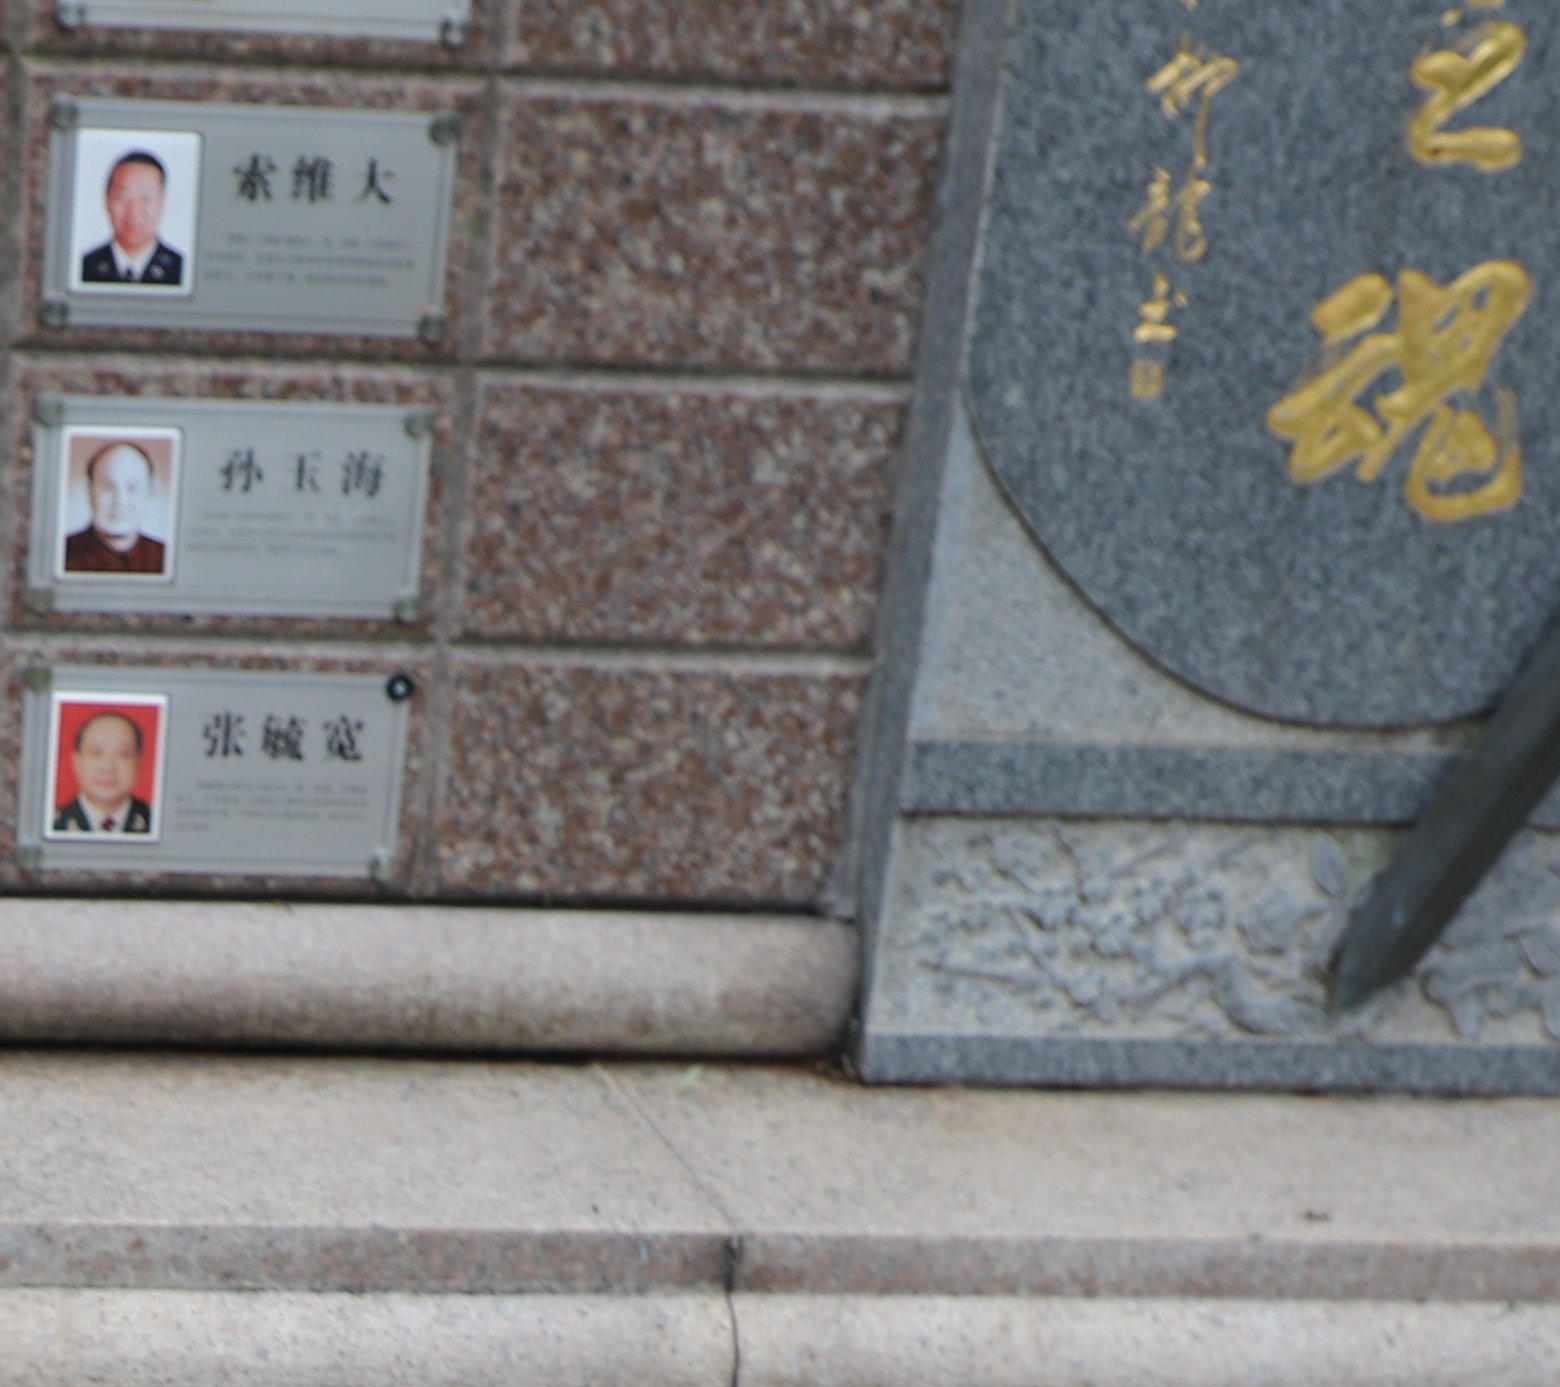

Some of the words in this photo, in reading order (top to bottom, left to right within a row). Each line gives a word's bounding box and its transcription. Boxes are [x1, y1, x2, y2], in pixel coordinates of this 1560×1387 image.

[1266, 0, 1533, 521] 之魂
[219, 448, 386, 501] 孙玉海
